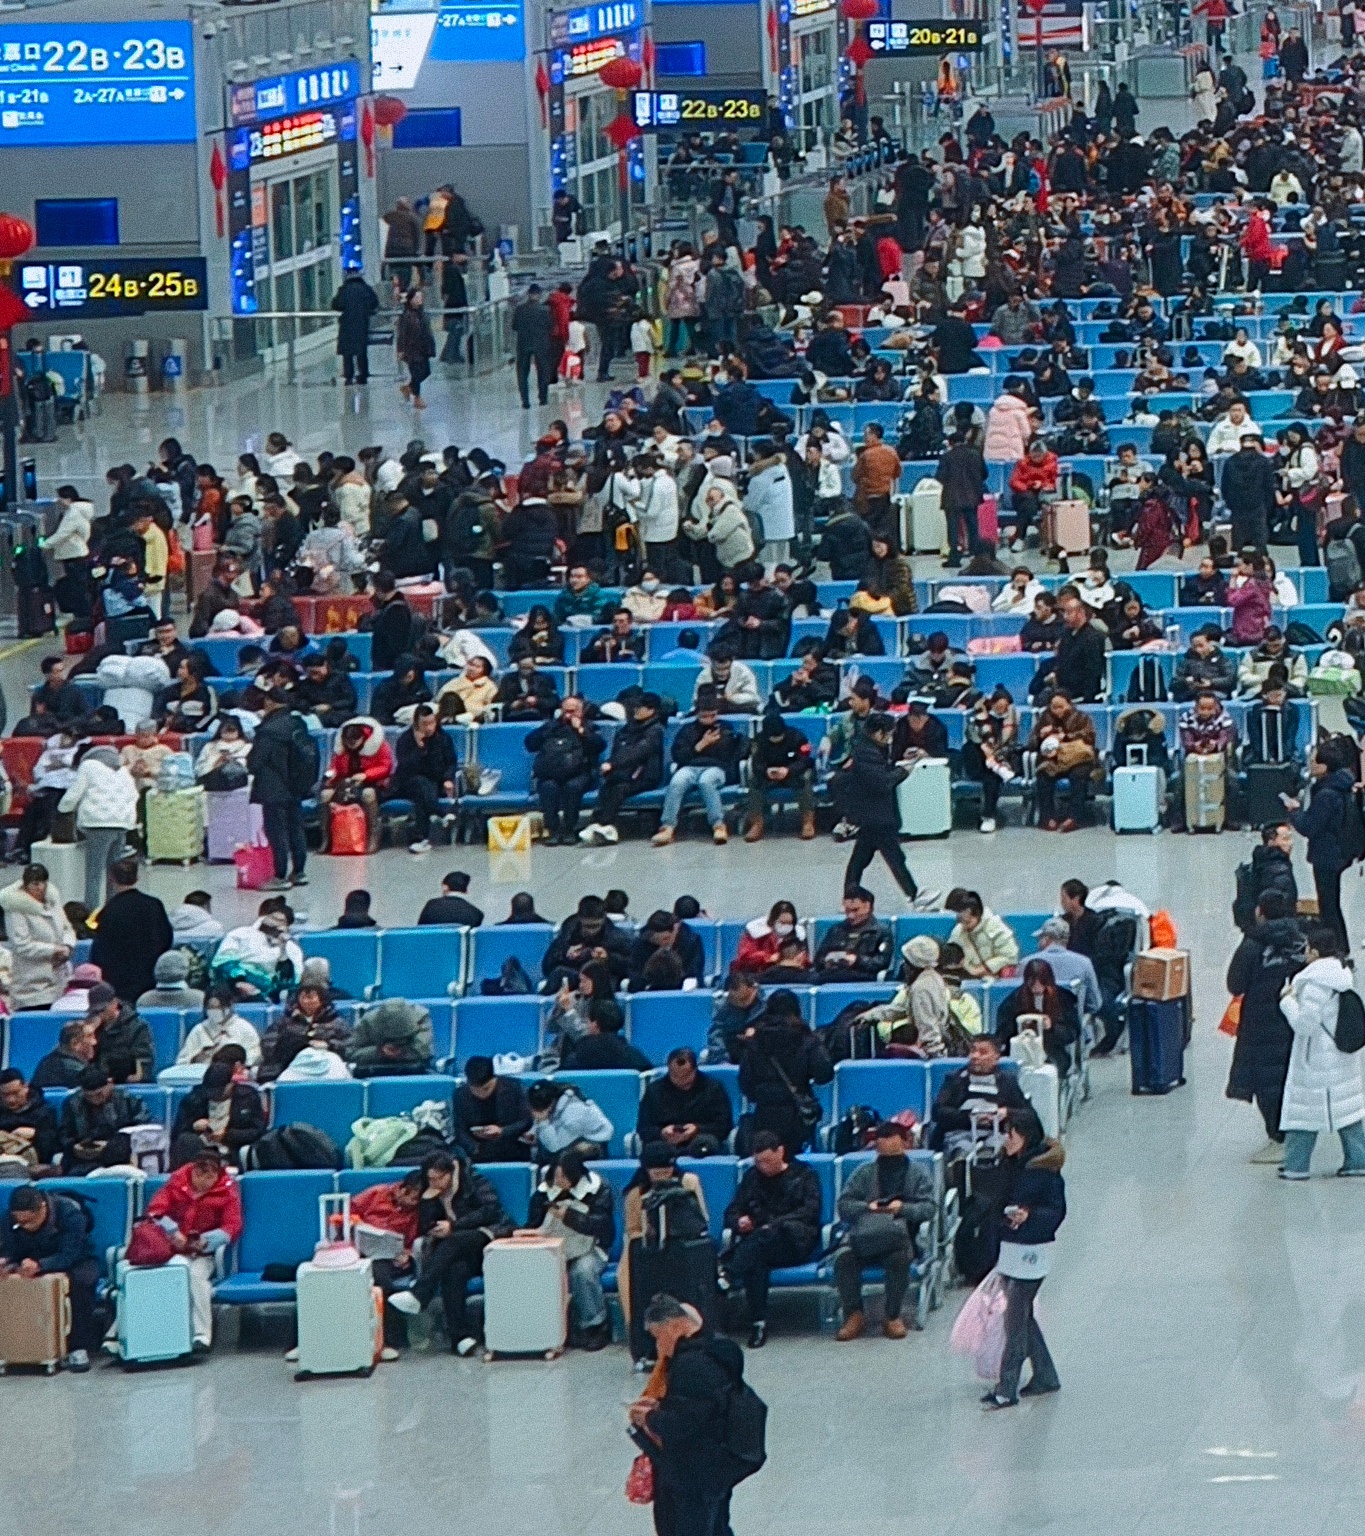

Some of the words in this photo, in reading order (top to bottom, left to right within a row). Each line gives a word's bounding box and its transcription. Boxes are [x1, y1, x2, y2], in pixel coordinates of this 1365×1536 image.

[909, 28, 978, 45] 20B·21B
[43, 38, 186, 72] 22B·23B
[681, 99, 761, 119] 22B·23B
[88, 271, 199, 299] 24B·25B
